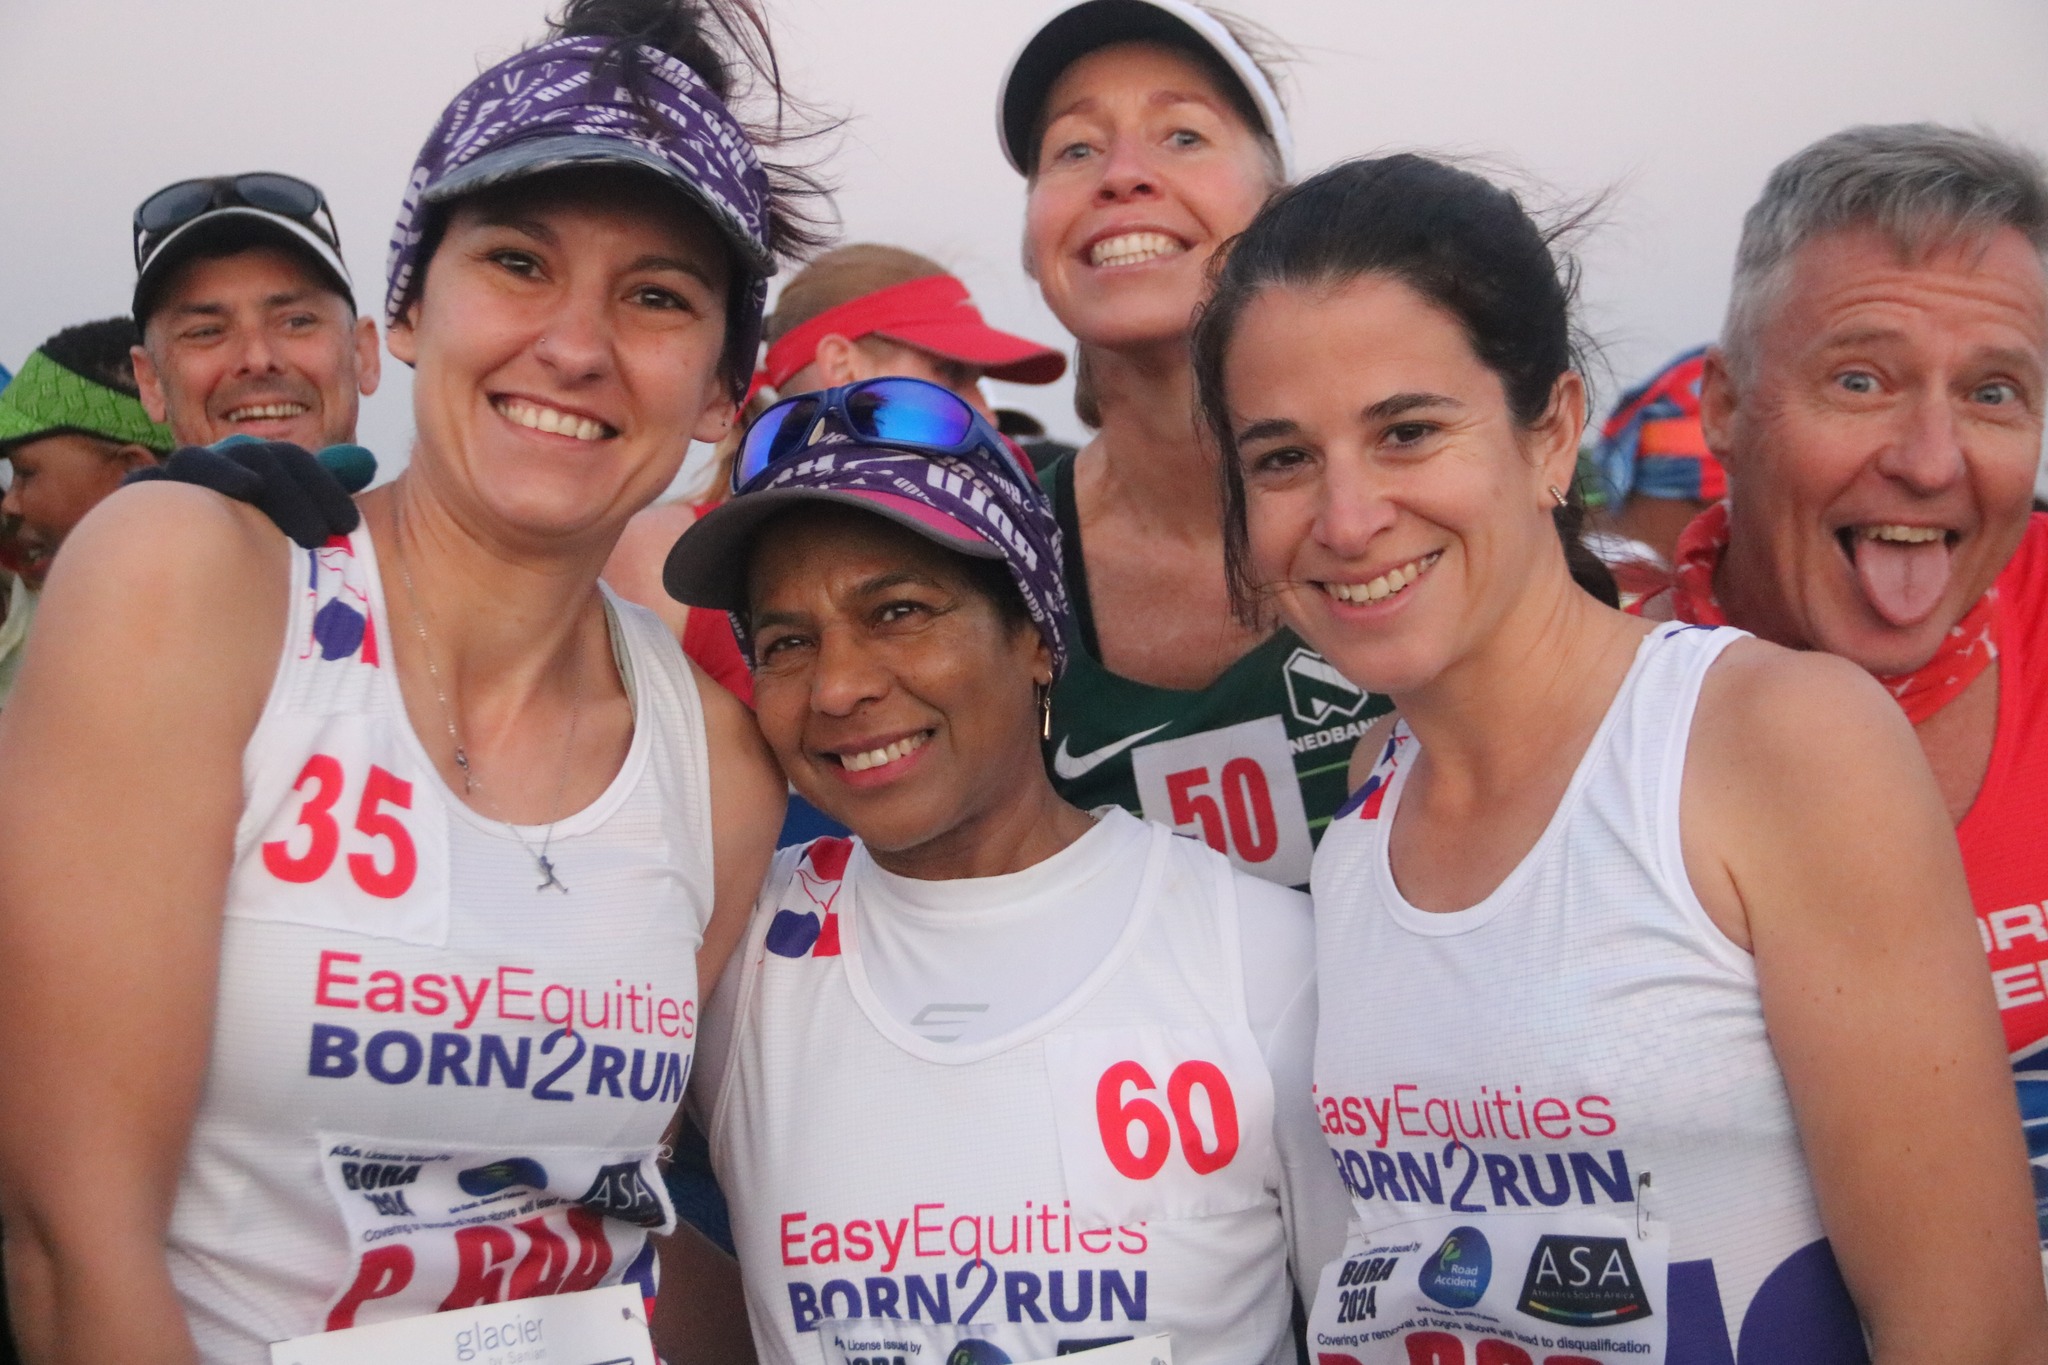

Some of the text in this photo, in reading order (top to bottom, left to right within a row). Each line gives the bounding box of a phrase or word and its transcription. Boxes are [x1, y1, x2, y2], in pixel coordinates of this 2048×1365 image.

[613, 86, 688, 129] Brn
[926, 463, 1039, 572] Born
[1287, 715, 1385, 756] NEDBAN
[261, 753, 418, 899] 35
[1164, 757, 1279, 864] 50
[312, 949, 695, 1040] EasyEquities
[307, 1023, 691, 1104] BORN2RUN
[1095, 1059, 1240, 1181] 60
[1311, 1083, 1617, 1150] asyEquities
[586, 1170, 655, 1210] ASA
[780, 1200, 1149, 1274] EasyEquities
[1337, 1256, 1400, 1288] BORA
[1434, 1275, 1478, 1288] Accident
[1451, 1263, 1479, 1276] Road
[1535, 1245, 1631, 1288] ASA
[787, 1258, 1148, 1333] BORN2RUN
[1336, 1285, 1377, 1324] 2024
[455, 1313, 544, 1362] glacier
[847, 1339, 882, 1351] License
[910, 1340, 922, 1356] by
[1317, 1333, 1359, 1347] Covering
[1359, 1331, 1370, 1343] or
[1417, 1317, 1429, 1328] of
[1541, 1336, 1554, 1349] to
[1556, 1336, 1651, 1354] disqualification
